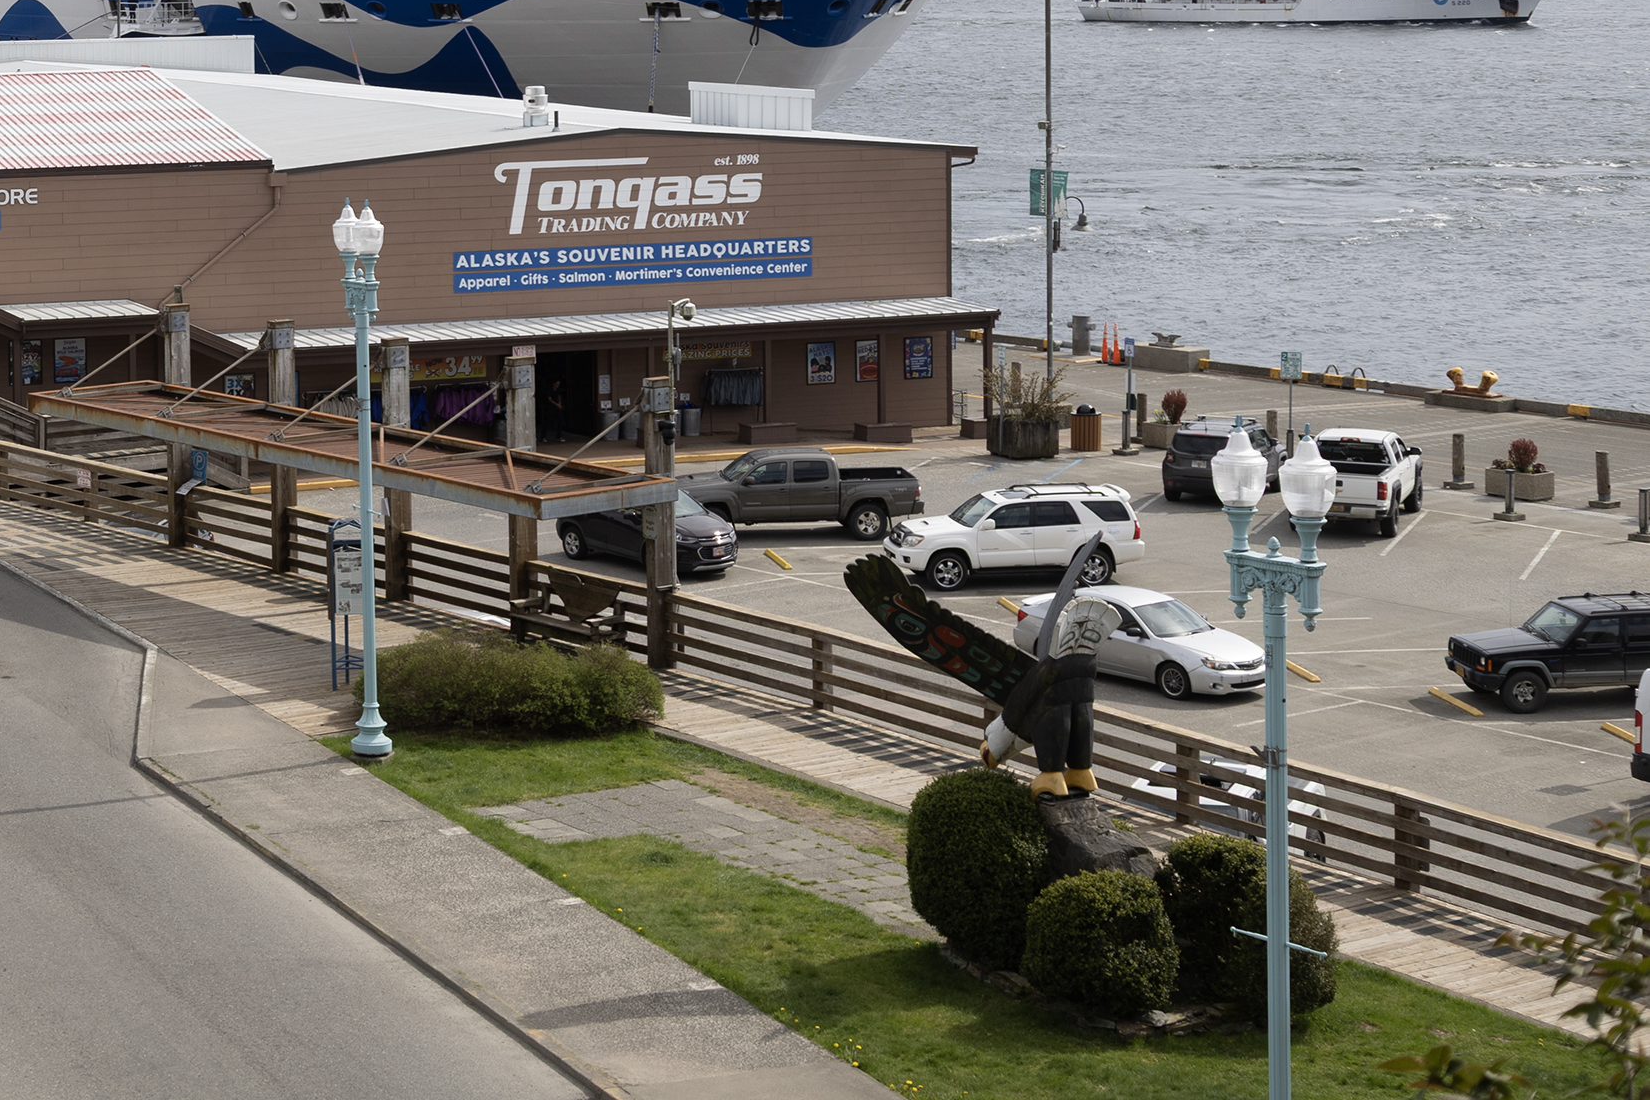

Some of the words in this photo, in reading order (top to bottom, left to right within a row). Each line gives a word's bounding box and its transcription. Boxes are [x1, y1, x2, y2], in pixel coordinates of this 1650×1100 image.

[714, 155, 733, 166] est.
[736, 154, 760, 165] 1898
[494, 156, 763, 235] Tongass
[537, 215, 630, 234] TRADING
[651, 210, 750, 230] COMPANY
[456, 250, 550, 268] ALASKA'S
[557, 246, 654, 263] SOUVENIR
[661, 239, 811, 259] HEADQUARTERS
[459, 275, 510, 290] Apparel
[520, 273, 549, 285] Gifts
[558, 272, 606, 284] Salmon
[615, 268, 683, 281] Mortimer's
[686, 264, 764, 277] Convenience
[767, 262, 808, 273] Center
[701, 341, 749, 350] Souvenirs
[664, 350, 712, 360] AAZING
[715, 348, 750, 357] PRICES
[425, 358, 443, 367] NOW
[444, 356, 472, 377] 34
[471, 355, 483, 364] 99
[227, 378, 242, 389] 3X
[817, 374, 833, 382] $20
[196, 455, 202, 467] P
